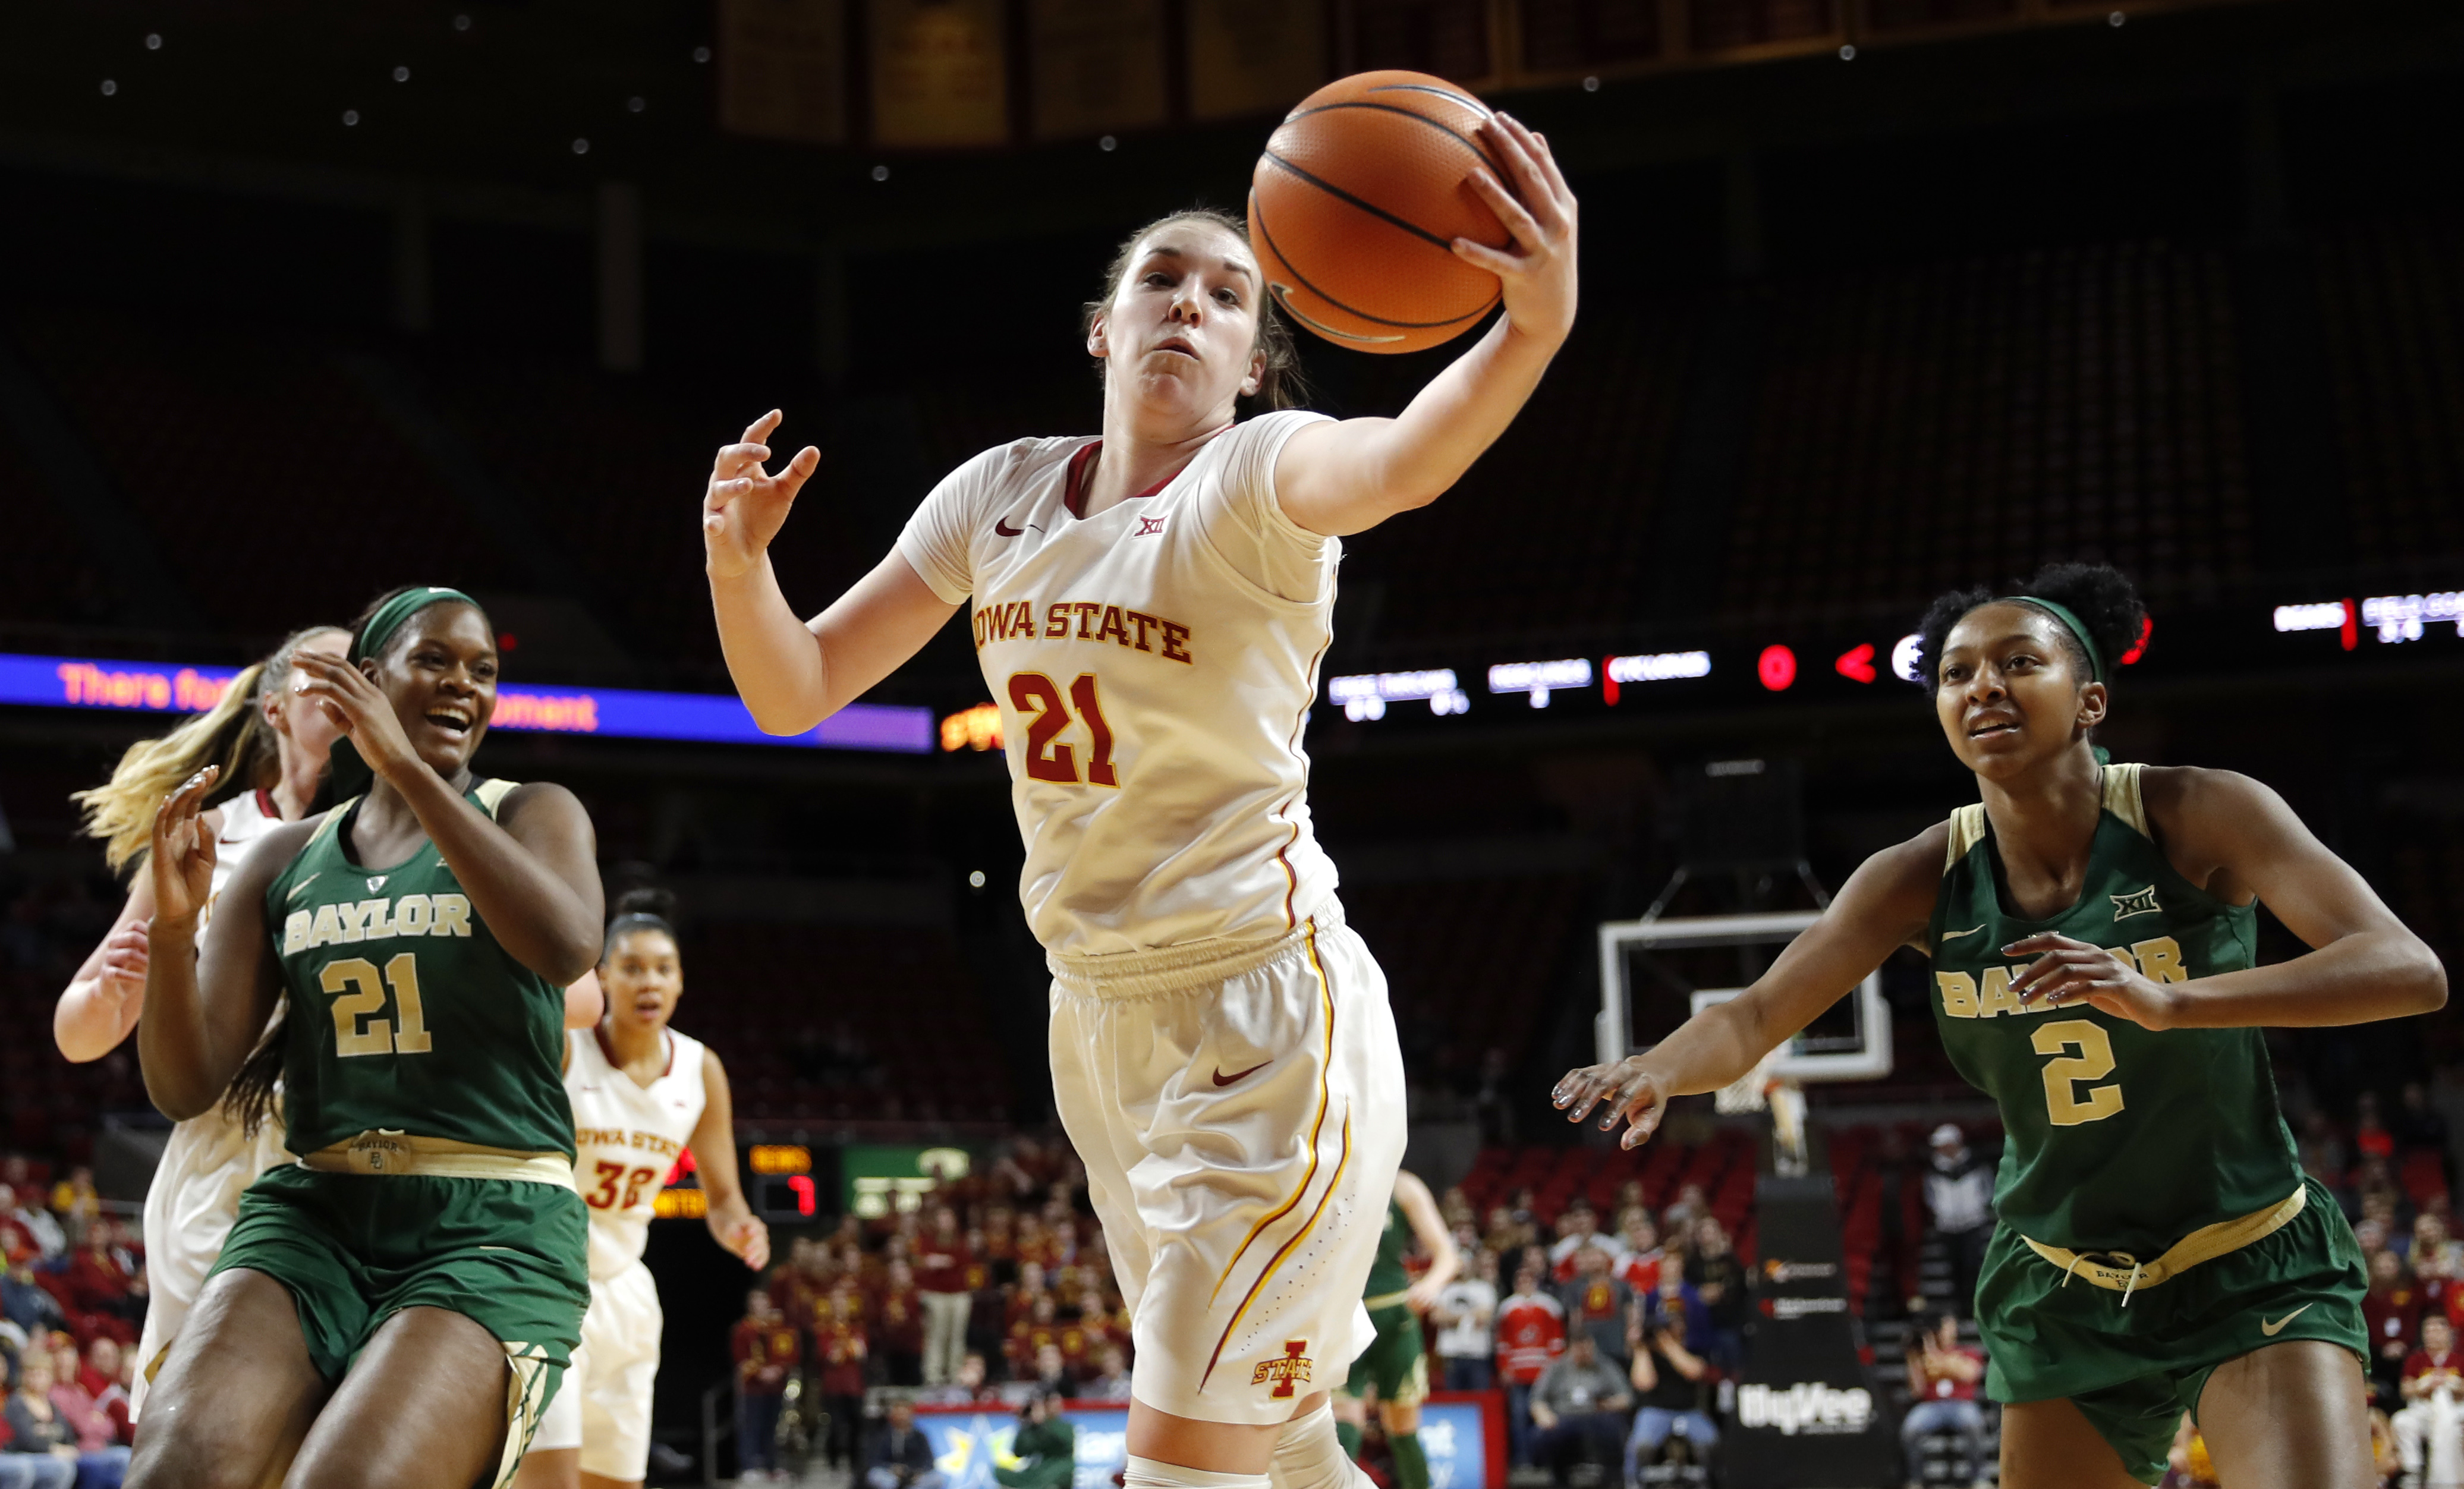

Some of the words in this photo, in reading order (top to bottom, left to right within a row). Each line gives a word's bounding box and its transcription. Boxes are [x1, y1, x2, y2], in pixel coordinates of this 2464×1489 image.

[1045, 601, 1194, 665] STATE
[58, 662, 171, 709] There
[1008, 671, 1121, 789] 21
[283, 893, 473, 957] BAYLOR
[318, 952, 433, 1058] 21
[1935, 936, 2188, 1019] BAR
[2029, 1018, 2125, 1126] 2
[576, 1127, 625, 1147] OWA
